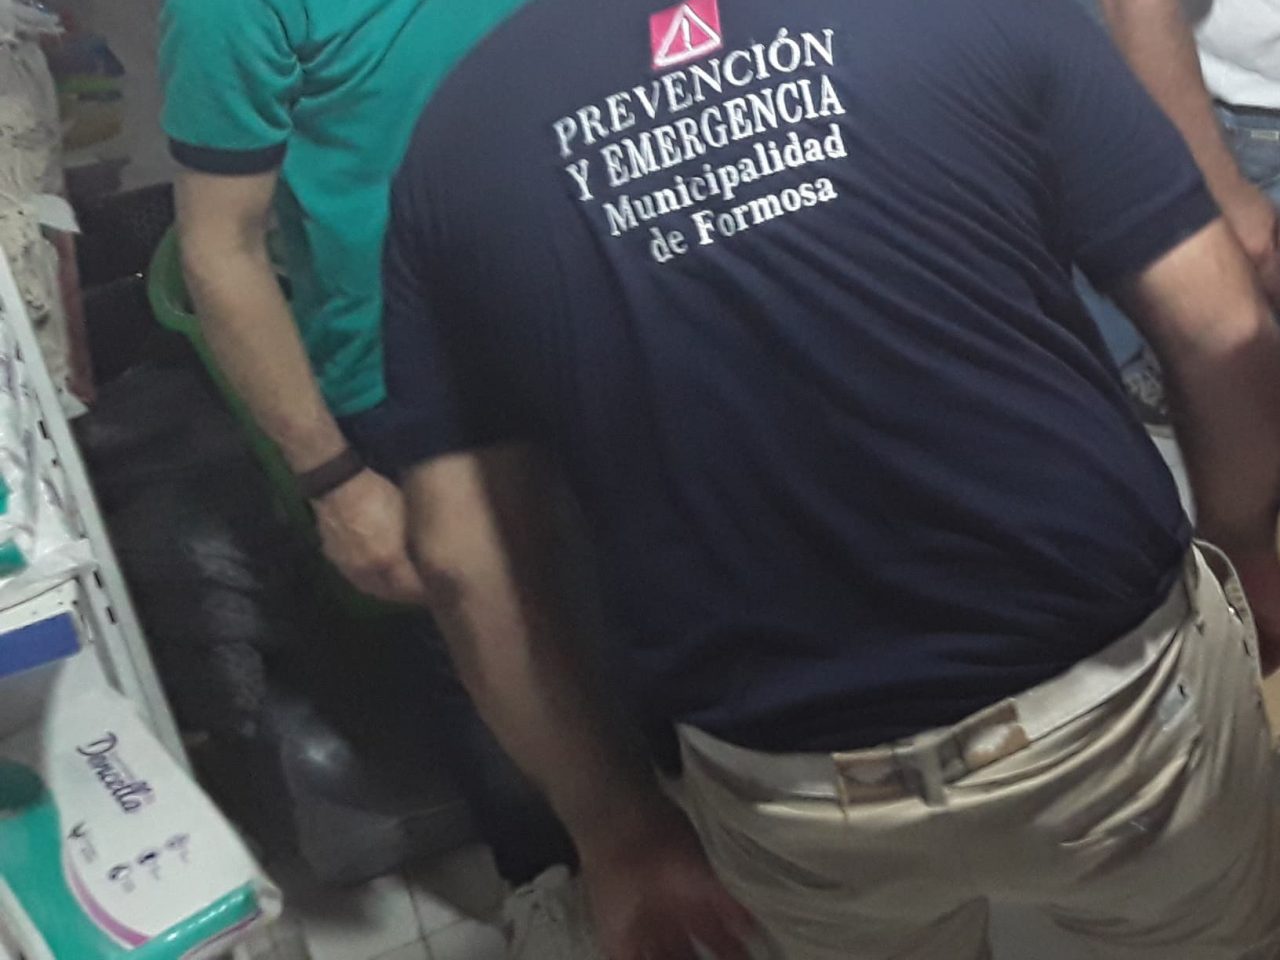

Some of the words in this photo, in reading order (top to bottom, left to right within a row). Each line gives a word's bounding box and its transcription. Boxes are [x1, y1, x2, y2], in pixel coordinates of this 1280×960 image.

[552, 27, 835, 158] PREVENCIÓN
[565, 158, 594, 202] Y
[600, 74, 847, 188] EMERGENCIA
[602, 123, 848, 237] Municipalidad
[650, 226, 688, 264] de
[690, 176, 838, 246] Formosa
